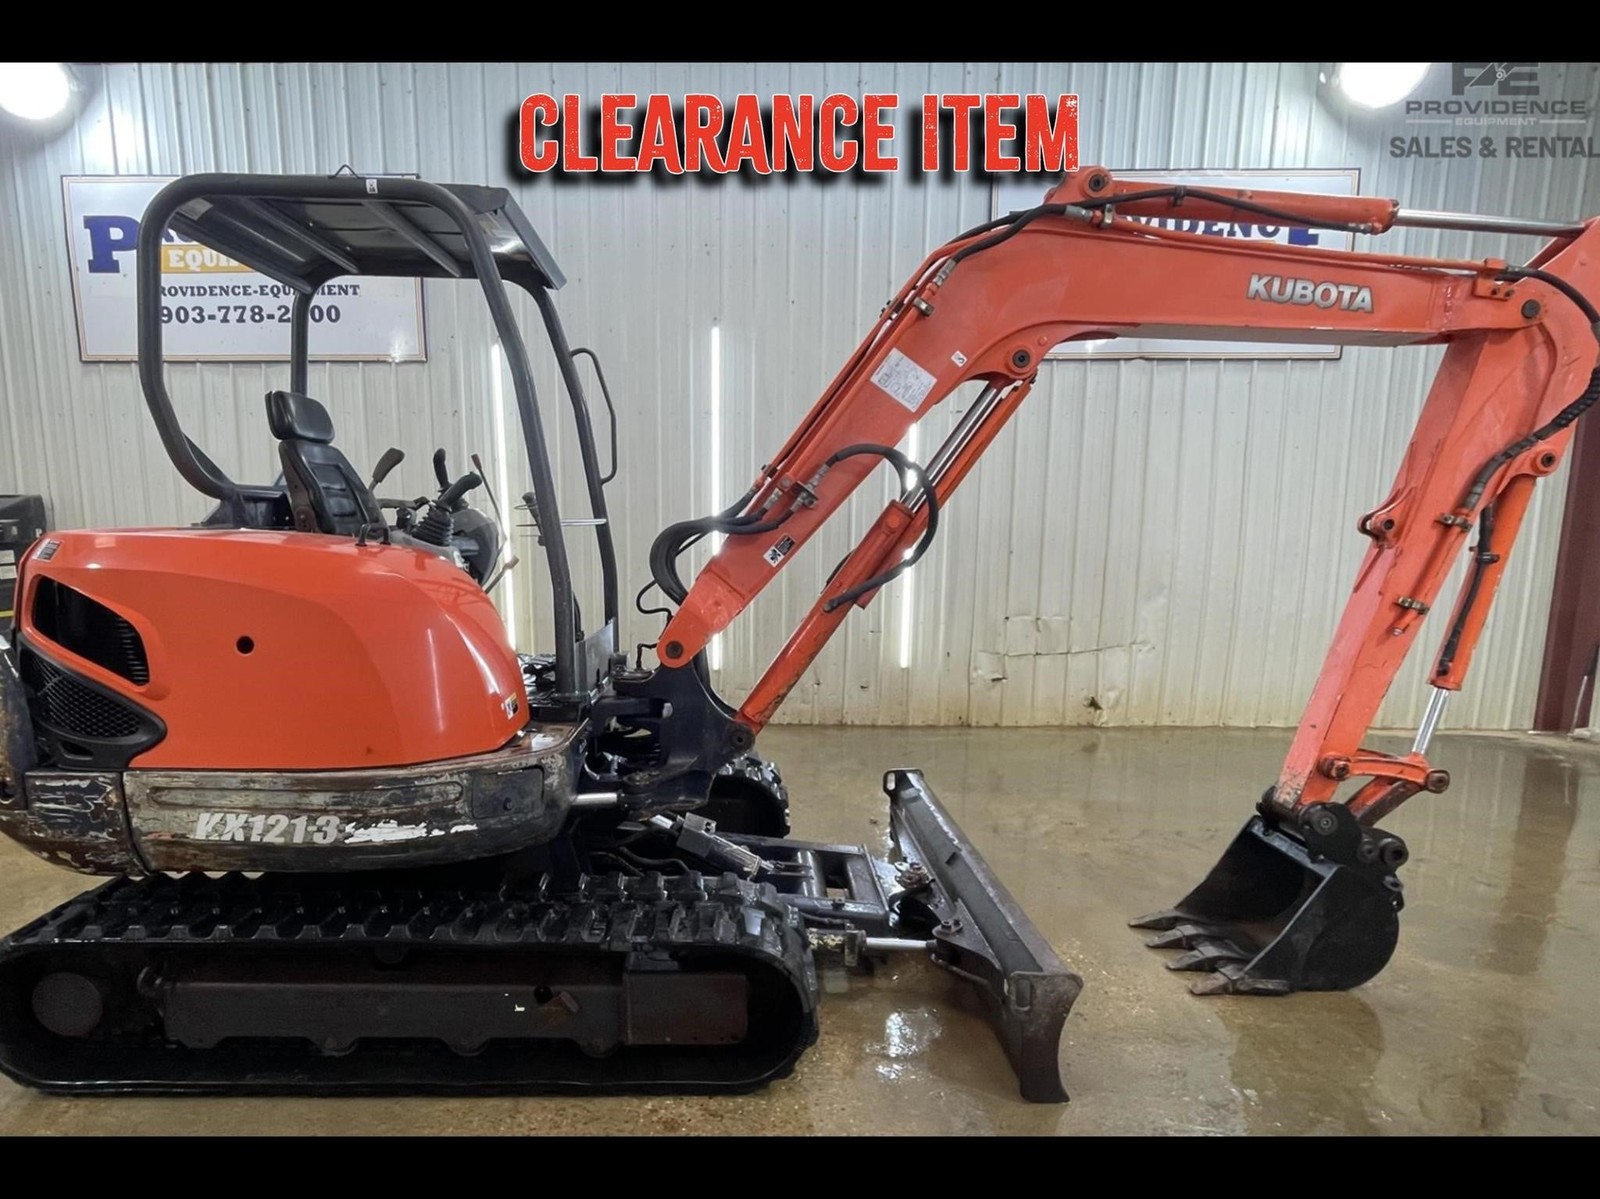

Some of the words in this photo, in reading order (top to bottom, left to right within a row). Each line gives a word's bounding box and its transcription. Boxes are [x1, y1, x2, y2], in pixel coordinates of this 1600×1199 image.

[1247, 272, 1374, 314] KUBOTA
[160, 304, 341, 324] 903-778-200
[193, 812, 341, 844] KX121-3
